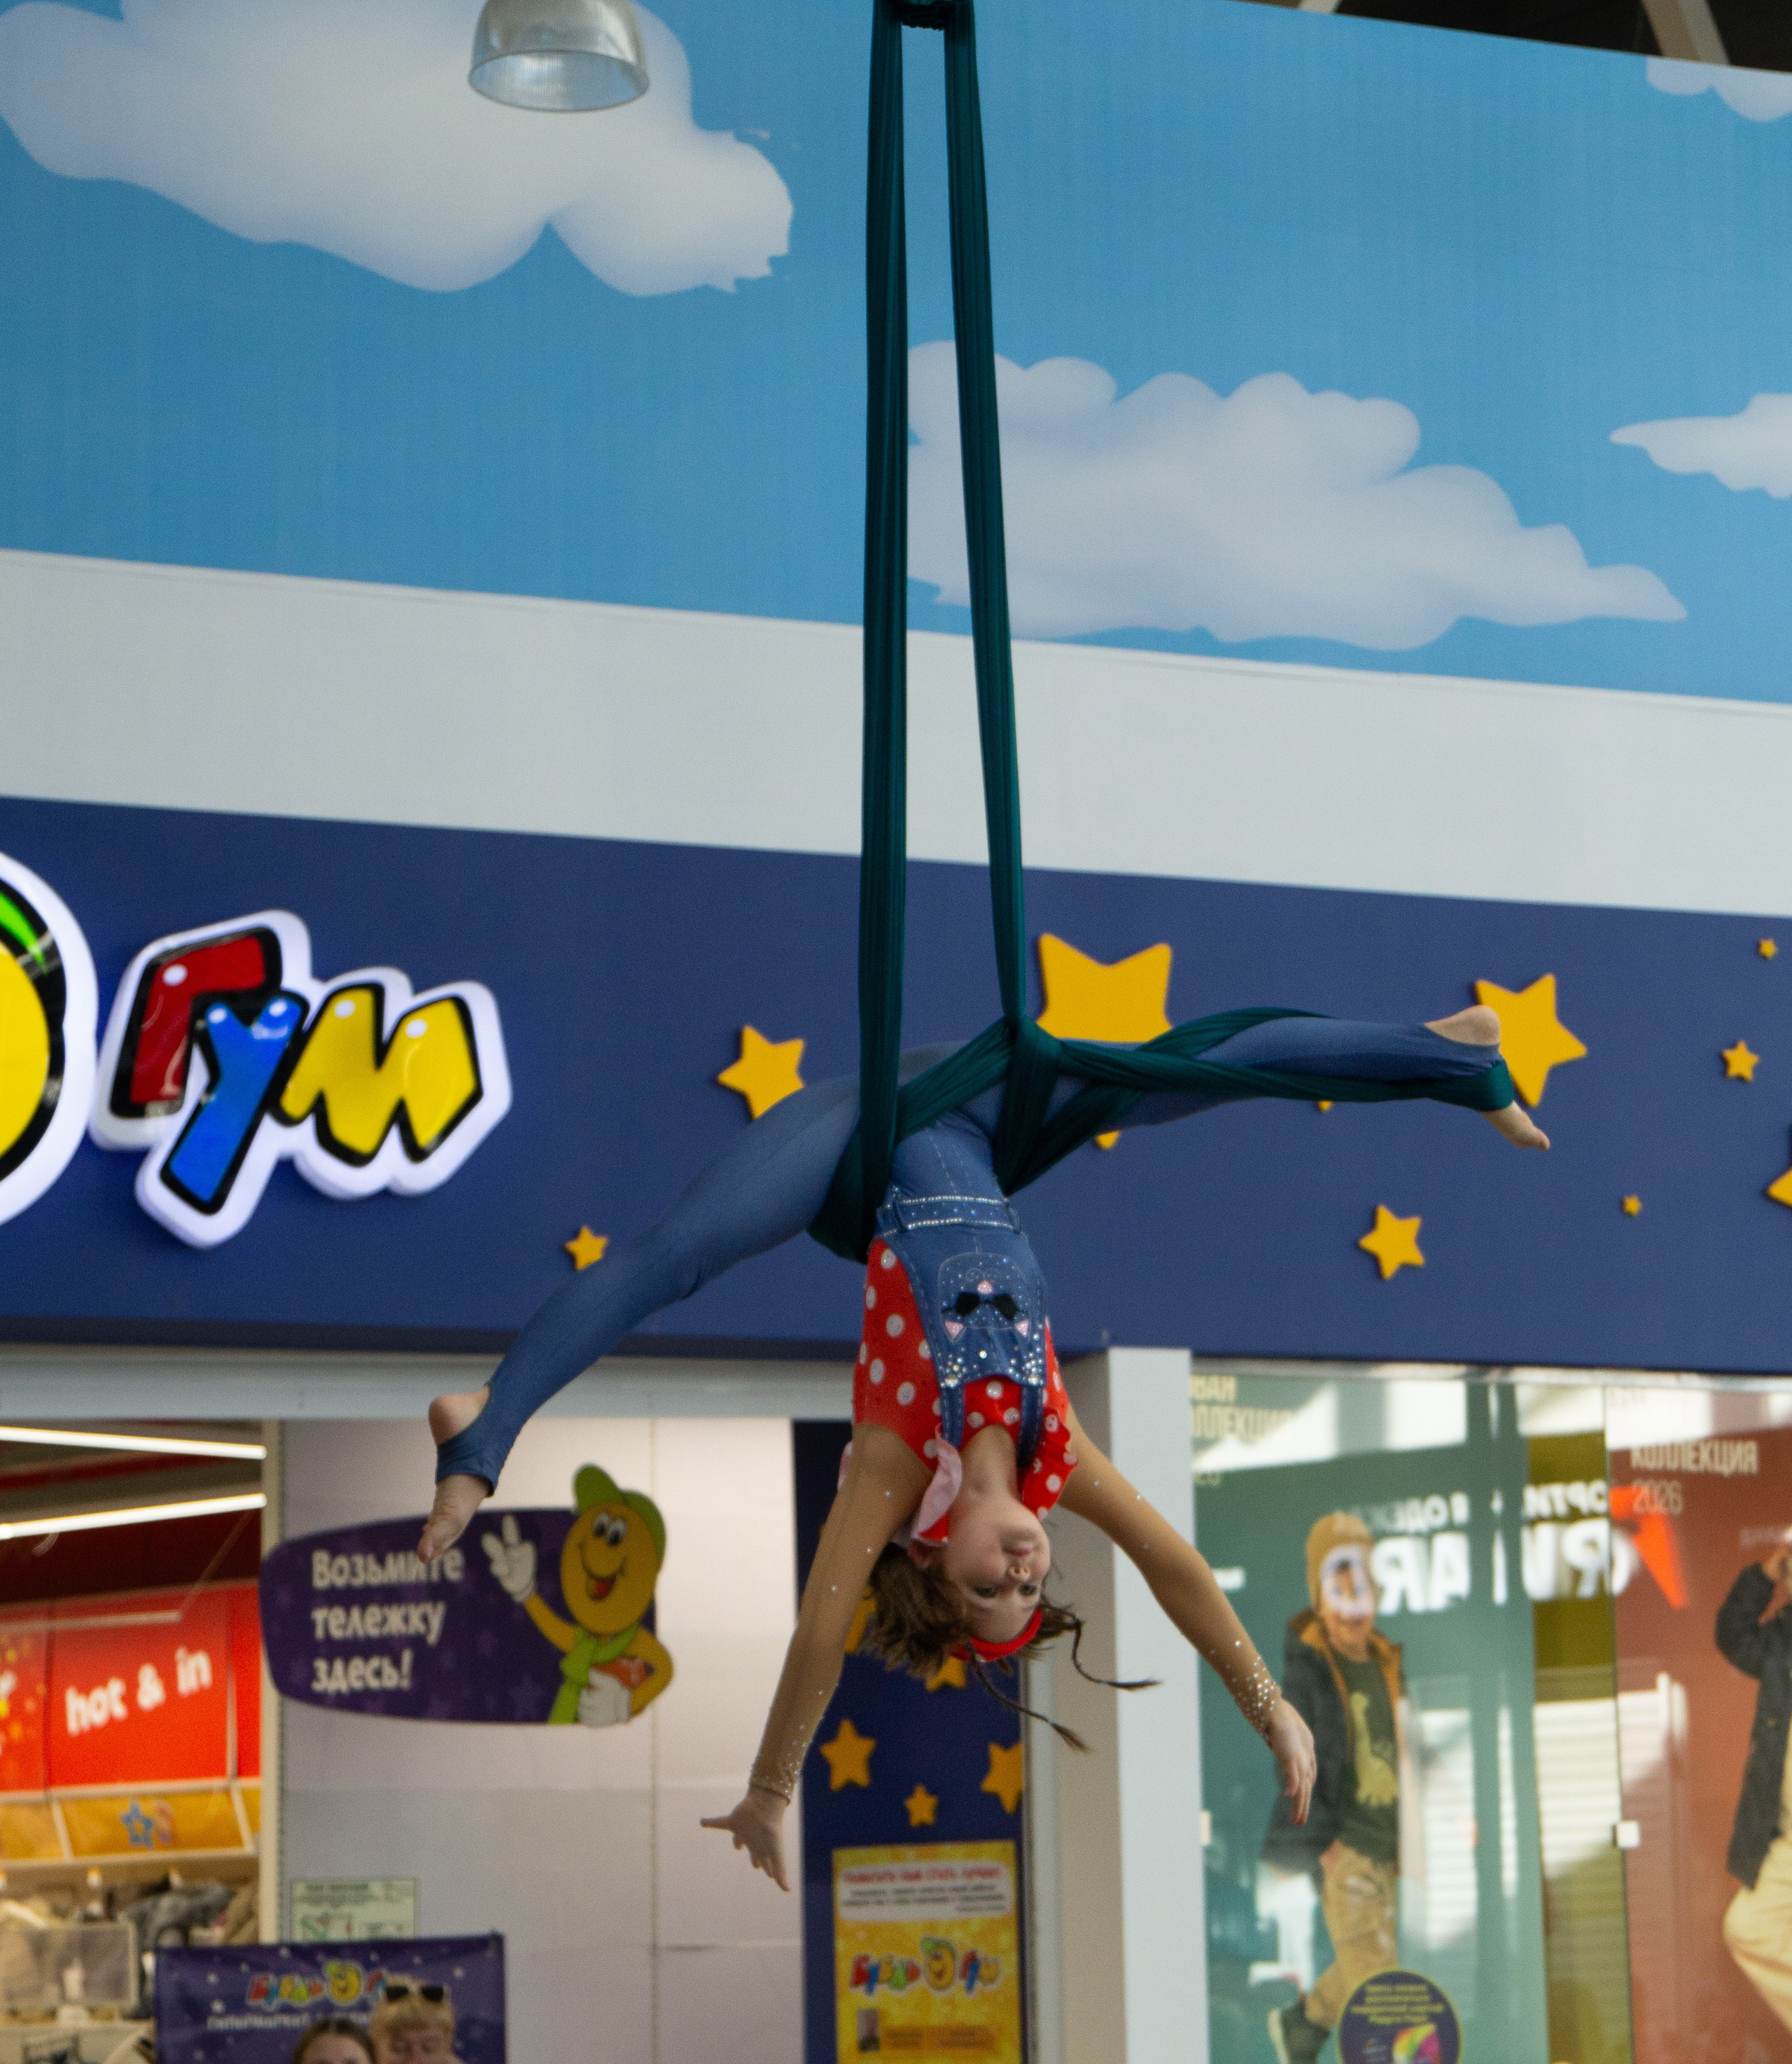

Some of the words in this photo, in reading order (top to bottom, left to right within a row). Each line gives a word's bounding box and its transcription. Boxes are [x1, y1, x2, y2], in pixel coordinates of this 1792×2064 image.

[1630, 1439, 1759, 1478] КОЛЛЕКЦИЯ
[312, 1548, 465, 1590] Возьмите
[312, 1601, 446, 1647] тележку
[65, 1678, 128, 1736] hot
[137, 1664, 166, 1711] &
[175, 1647, 211, 1696] in
[312, 1649, 413, 1693] здесь!
